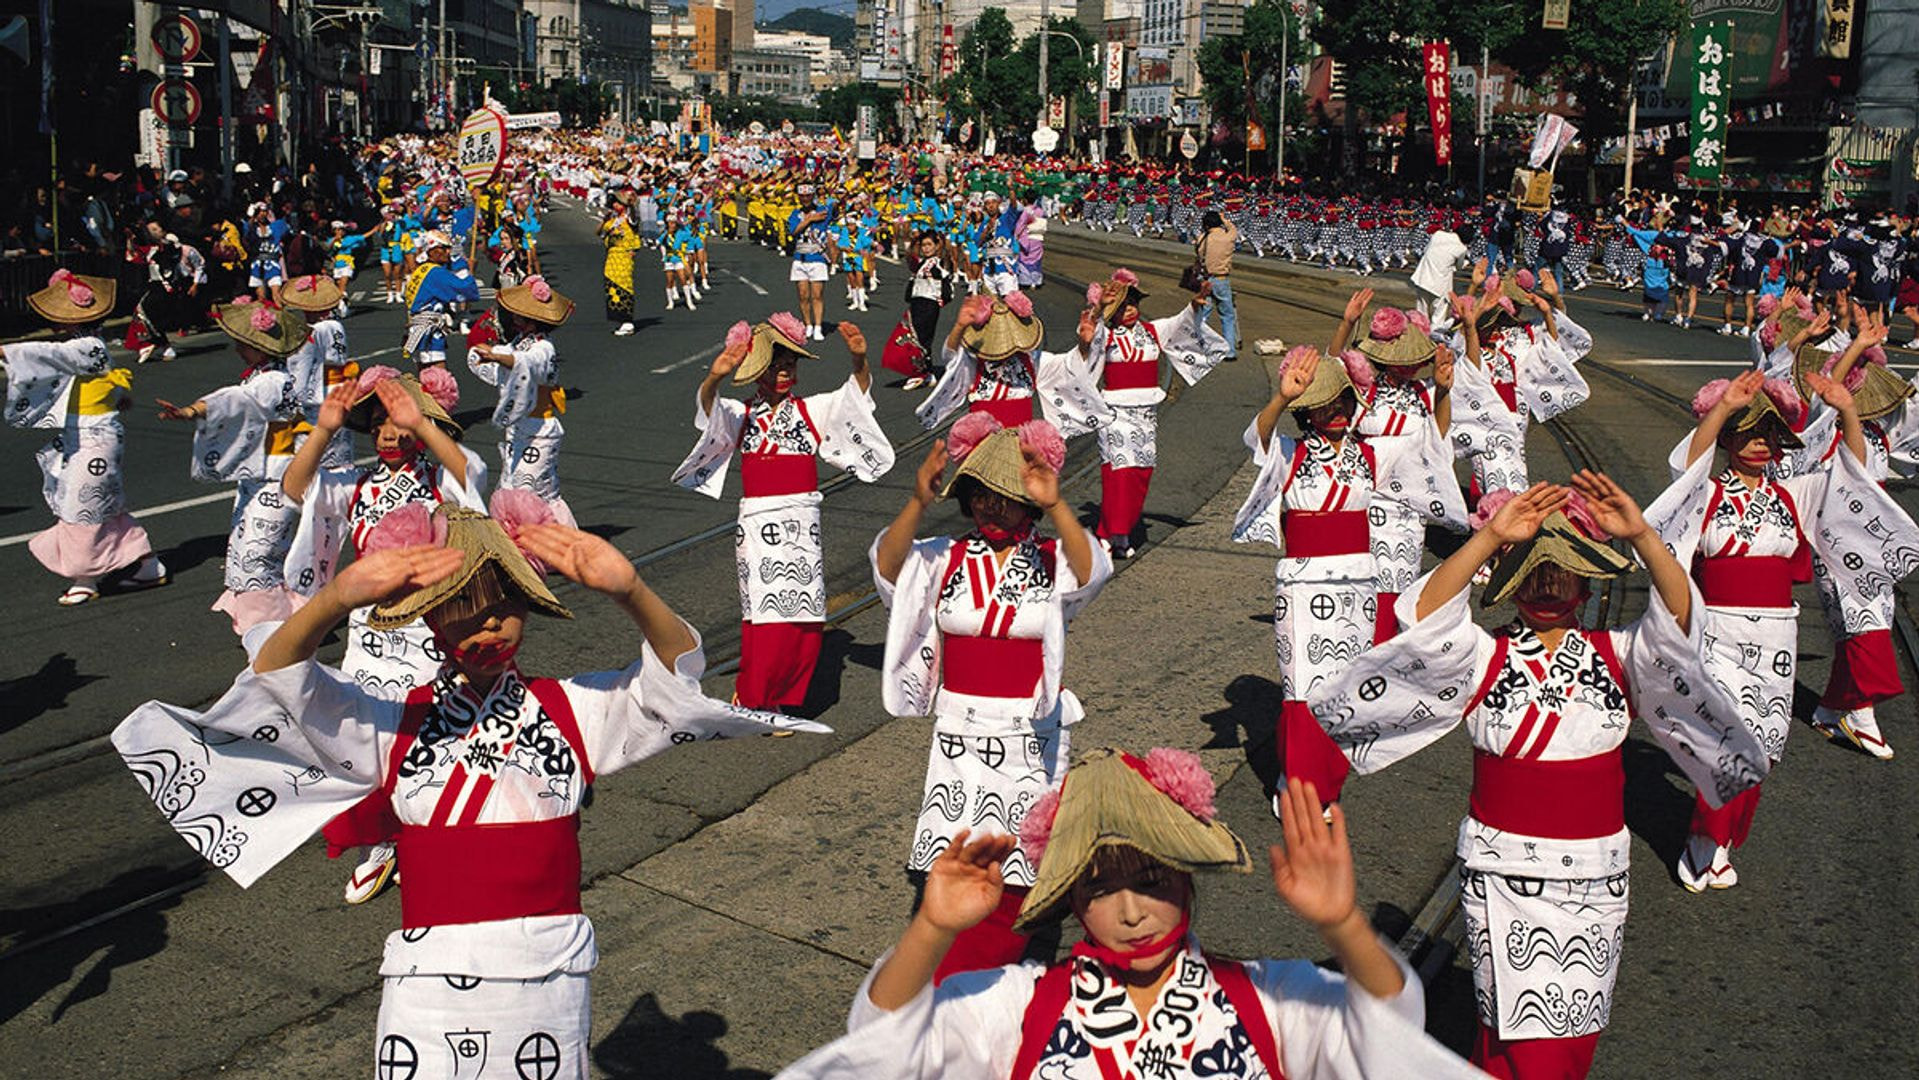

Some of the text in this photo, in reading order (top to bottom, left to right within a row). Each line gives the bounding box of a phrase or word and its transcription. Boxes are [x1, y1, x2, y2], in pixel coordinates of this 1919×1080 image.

[1109, 43, 1120, 81] ラーメン
[1429, 48, 1449, 158] おはら祭
[1693, 34, 1723, 168] おはら祭
[1536, 632, 1586, 711] 第30回
[464, 675, 525, 773] 第30回
[1135, 956, 1207, 1080] 第30回
